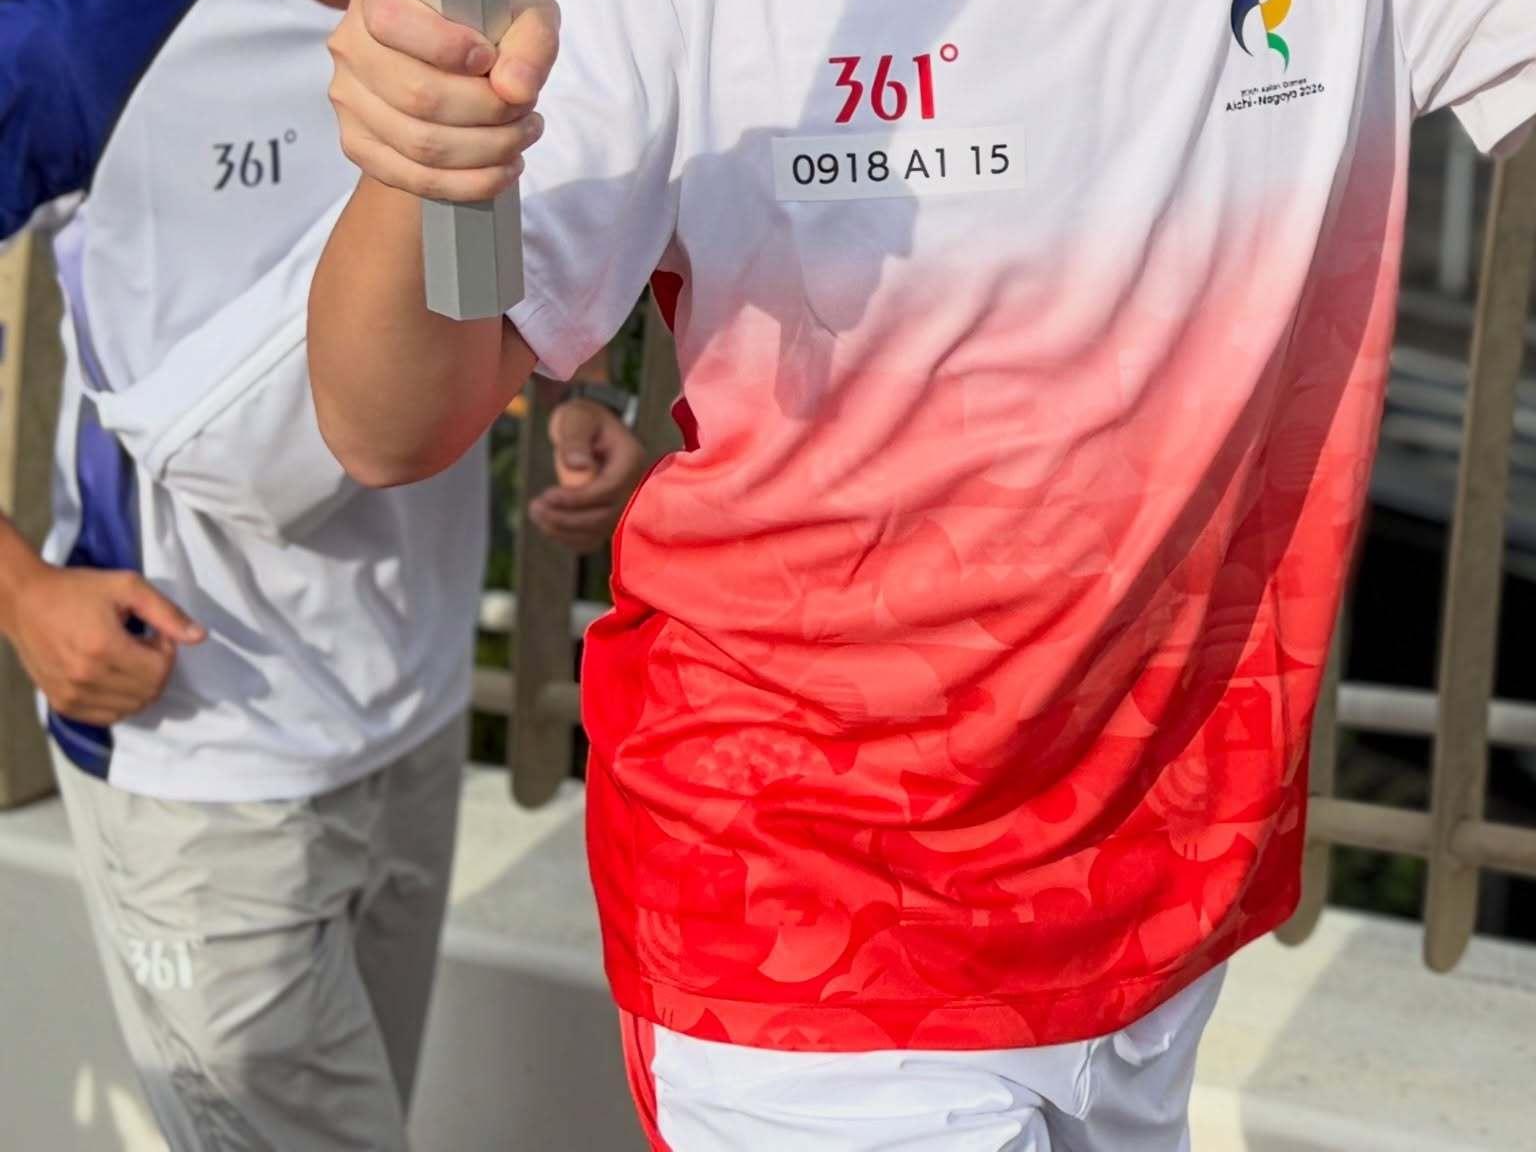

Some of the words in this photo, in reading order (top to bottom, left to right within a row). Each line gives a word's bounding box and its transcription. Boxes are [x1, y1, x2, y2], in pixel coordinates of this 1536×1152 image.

[792, 151, 889, 185] 0918
[904, 148, 946, 180] A1
[970, 144, 1009, 175] 15
